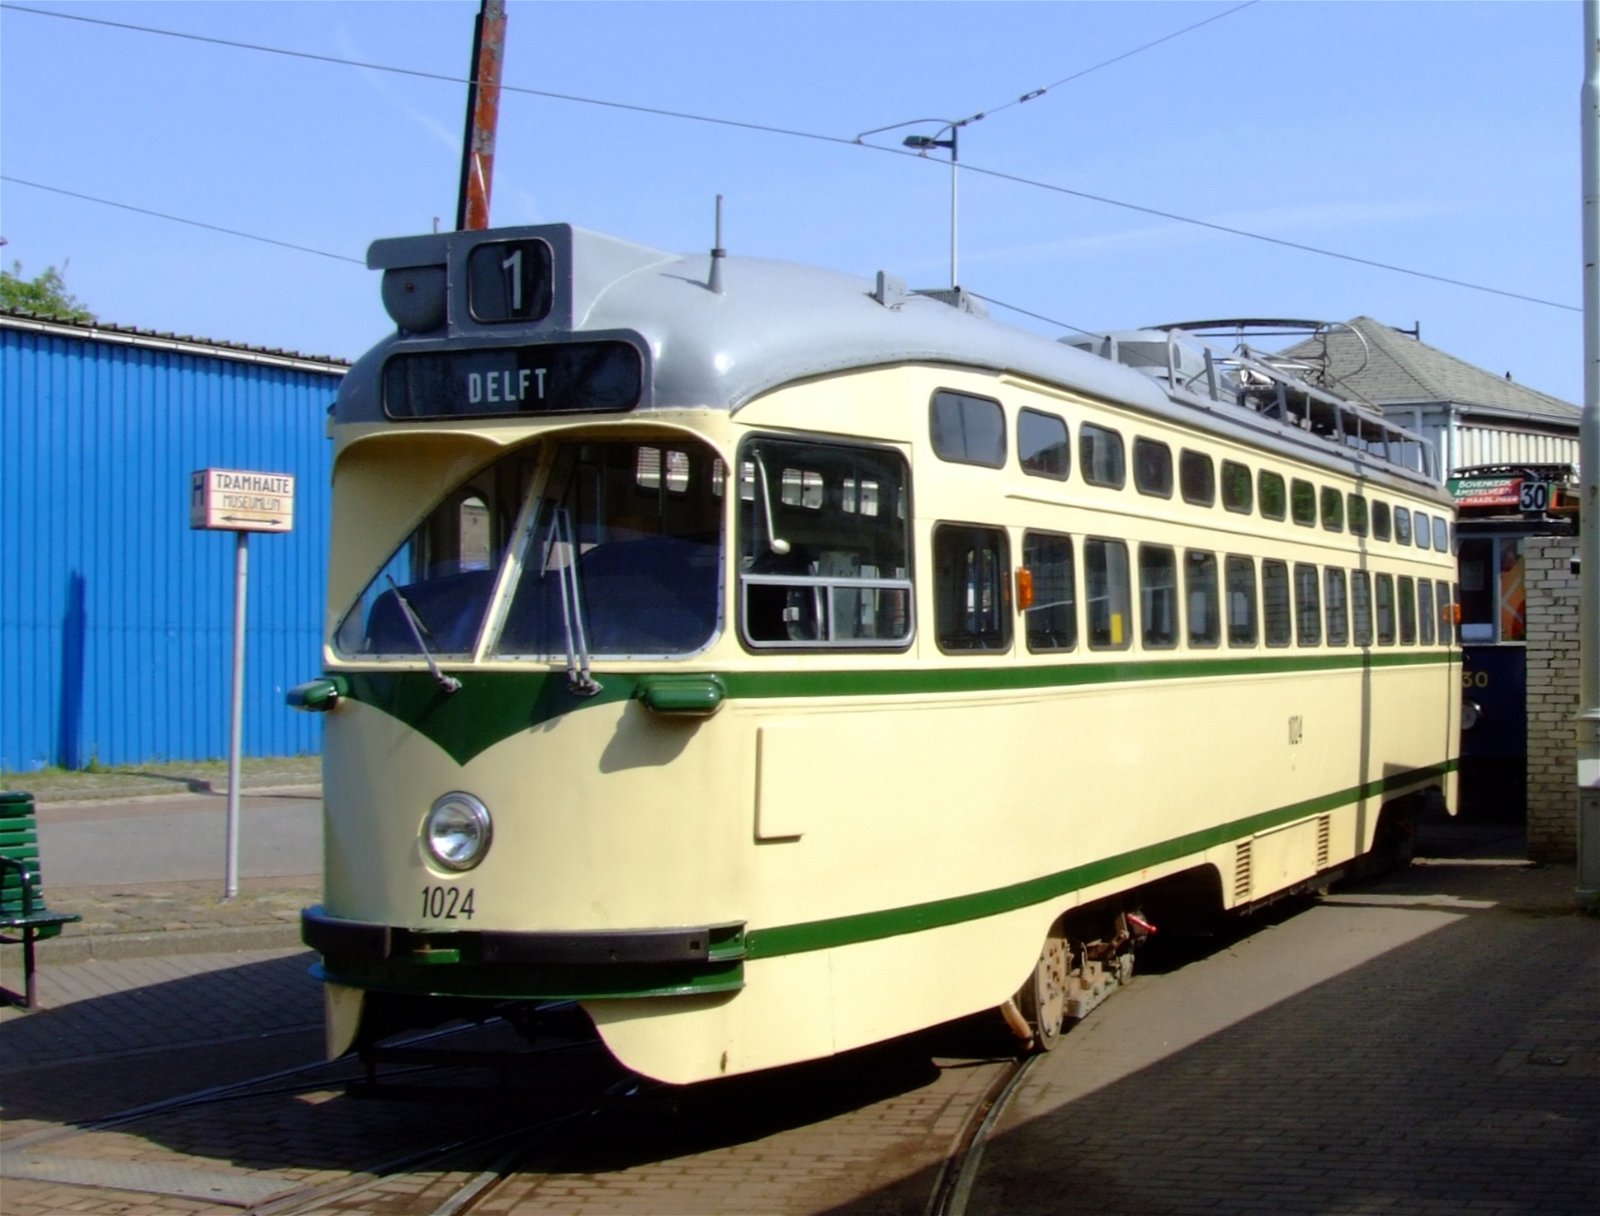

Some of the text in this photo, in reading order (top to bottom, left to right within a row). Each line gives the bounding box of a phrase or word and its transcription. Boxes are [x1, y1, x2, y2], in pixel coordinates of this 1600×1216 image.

[502, 249, 522, 311] 1
[468, 367, 547, 404] DELFT
[216, 473, 290, 494] TRAMHALTE
[1521, 483, 1546, 509] 30
[1288, 715, 1303, 745] 1024
[421, 885, 475, 920] 1024
